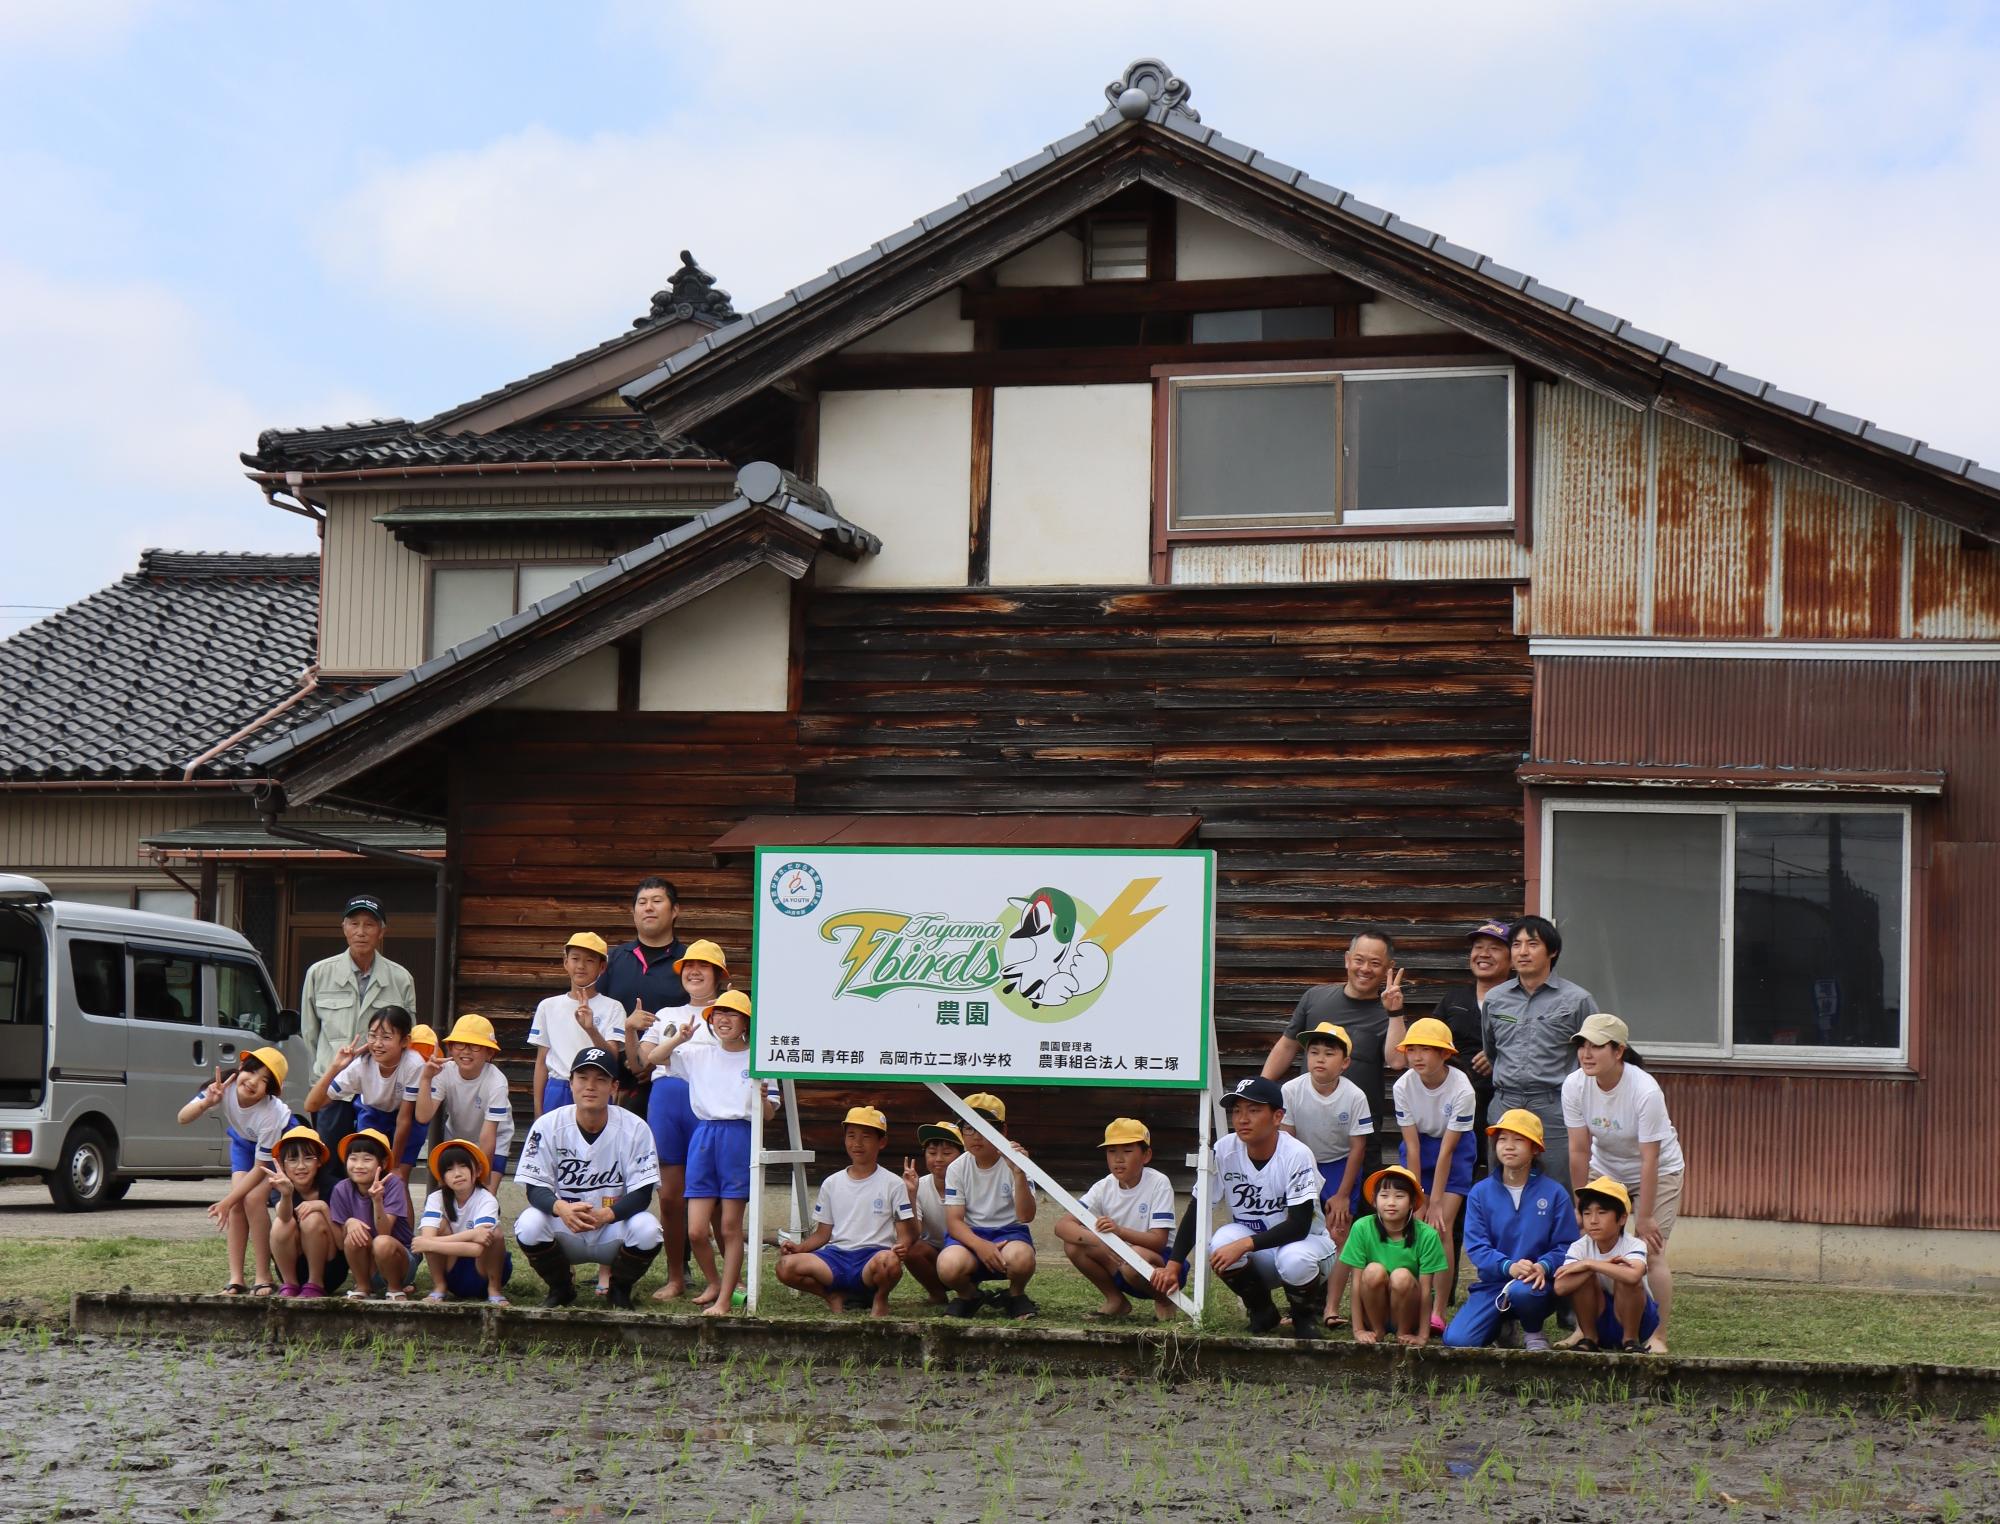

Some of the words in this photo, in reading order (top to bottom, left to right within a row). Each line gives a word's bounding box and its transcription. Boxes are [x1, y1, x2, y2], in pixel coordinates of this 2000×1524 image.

[905, 915, 999, 949] Toyama
[936, 1000, 989, 1026] 農園
[770, 1035, 800, 1046] 主催者
[1040, 1041, 1092, 1052] 農園管理者
[768, 1049, 815, 1063] JA高岡
[821, 1049, 865, 1065] 青年部
[879, 1051, 1012, 1067] 高岡市立二塚小学校
[1039, 1054, 1128, 1070] 農事組合法人
[1134, 1056, 1179, 1071] 東二塚
[558, 1159, 624, 1187] Birds
[1232, 1183, 1288, 1210] Bird
